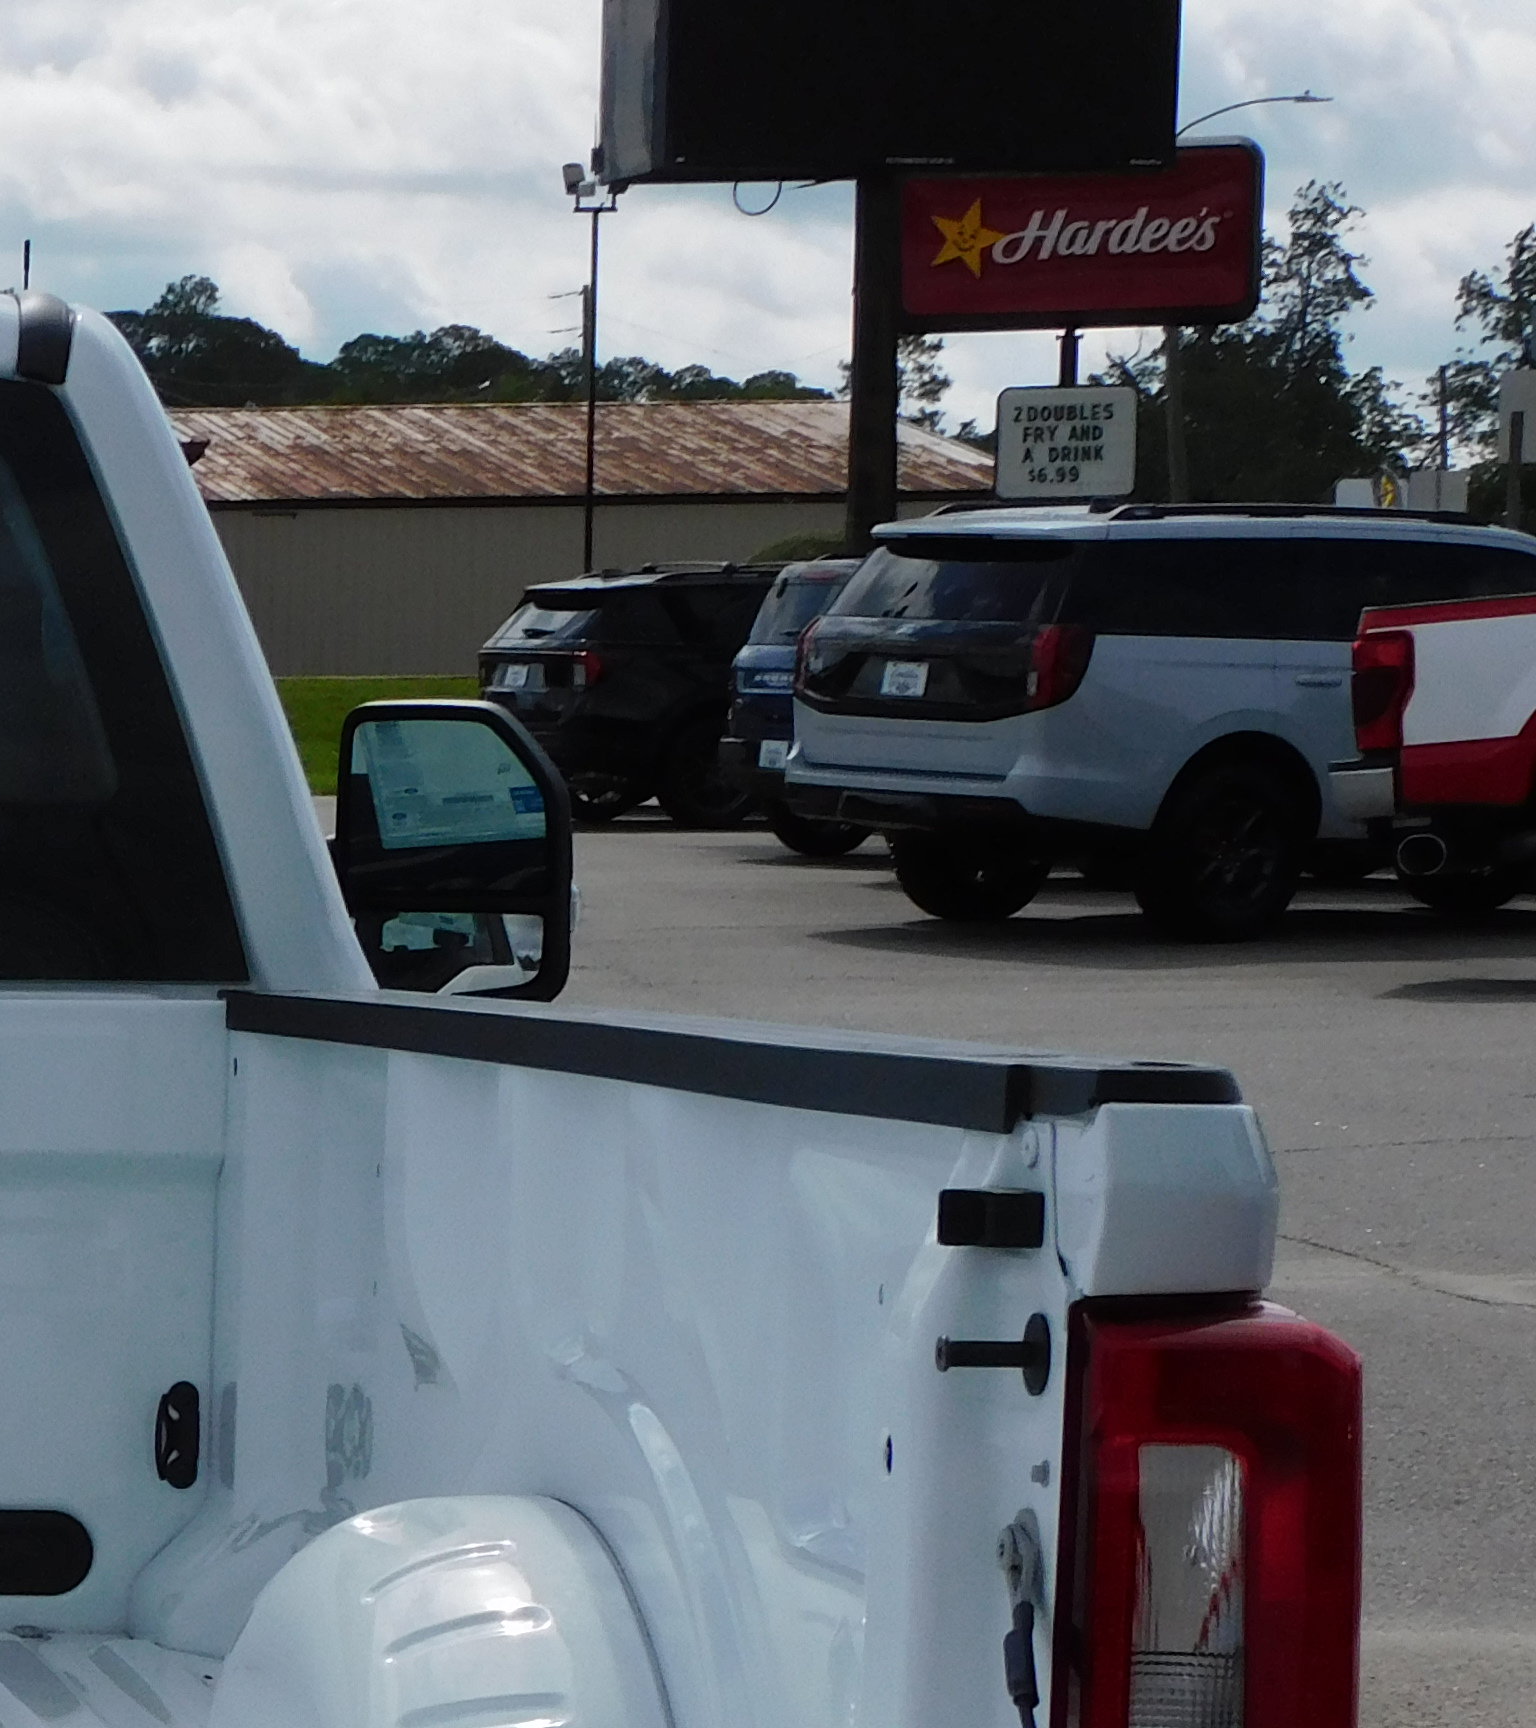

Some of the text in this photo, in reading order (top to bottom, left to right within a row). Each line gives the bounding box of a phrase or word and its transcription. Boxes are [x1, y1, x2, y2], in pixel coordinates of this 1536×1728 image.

[992, 206, 1221, 264] Hardee's
[1026, 403, 1114, 421] DOUBLES
[1022, 424, 1104, 443] FRY AND
[1021, 444, 1105, 463] A DRINK
[1028, 465, 1080, 483] $6.99
